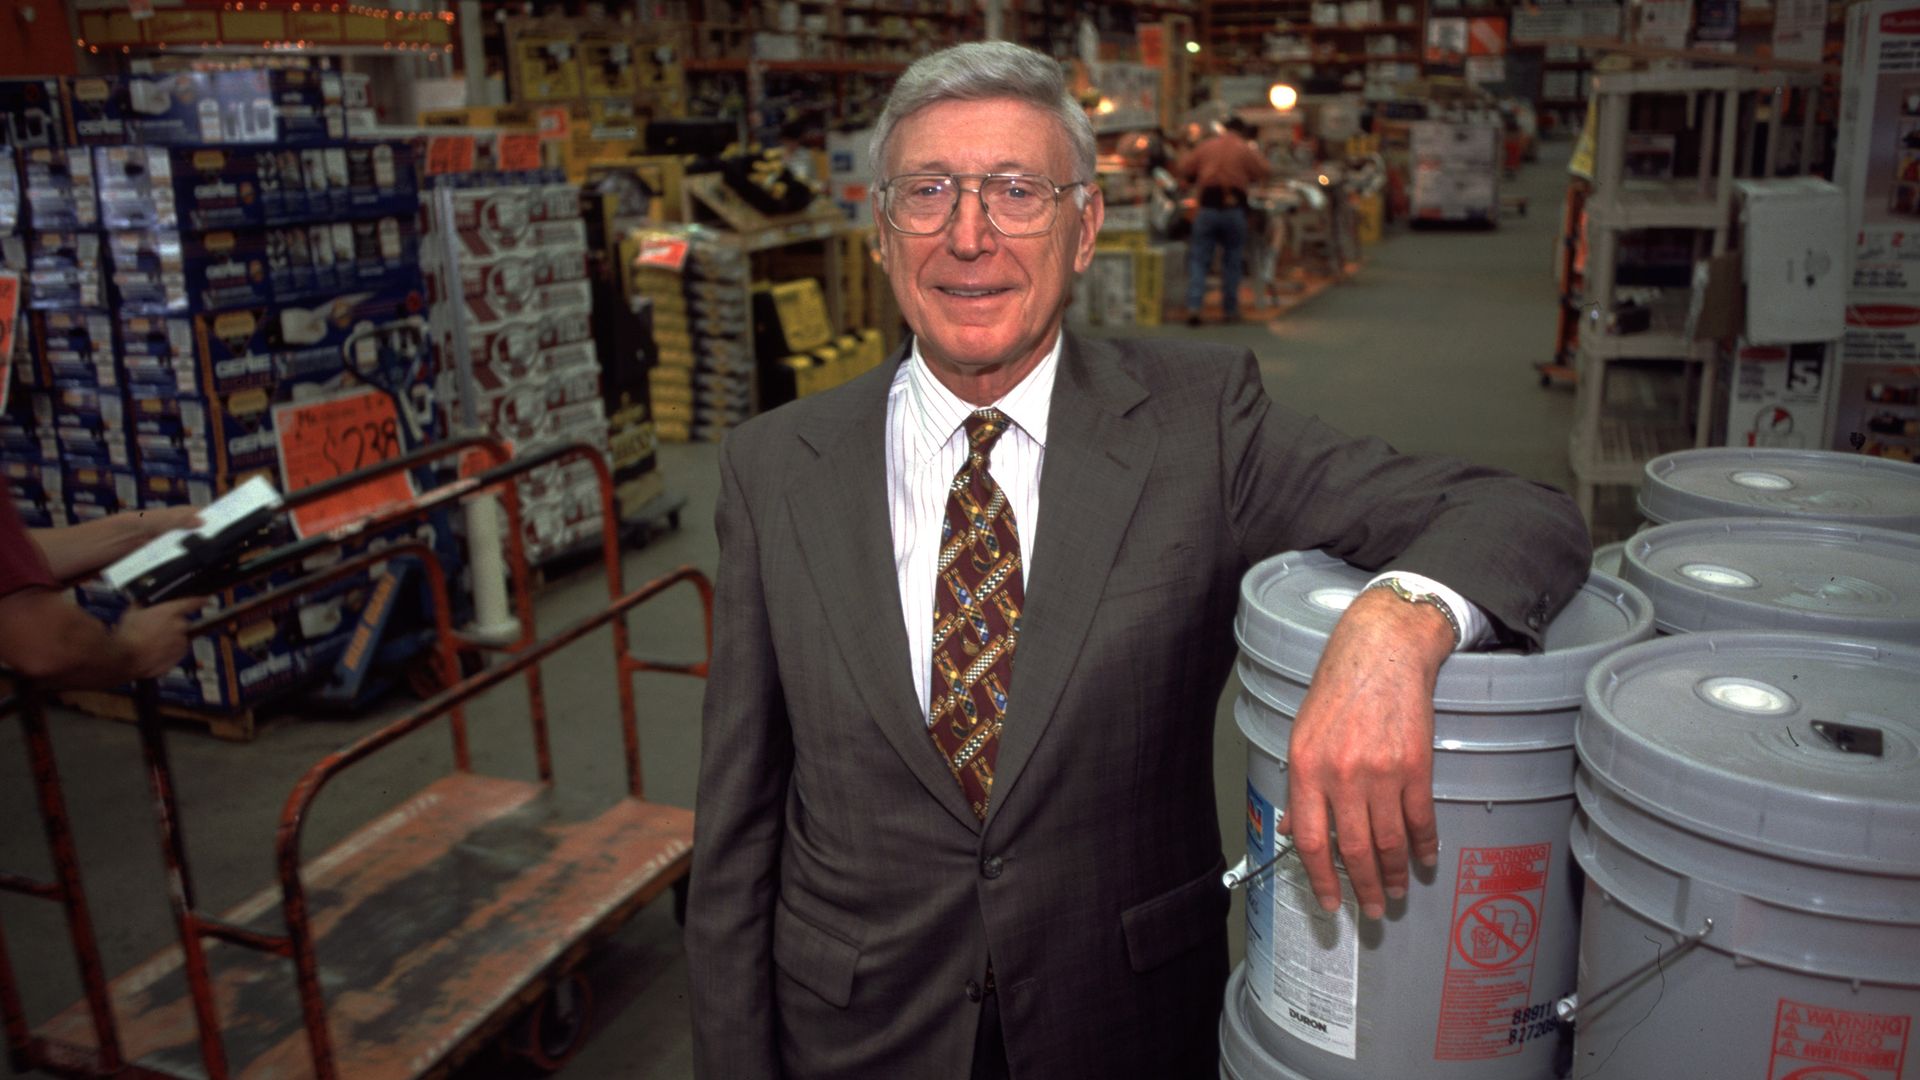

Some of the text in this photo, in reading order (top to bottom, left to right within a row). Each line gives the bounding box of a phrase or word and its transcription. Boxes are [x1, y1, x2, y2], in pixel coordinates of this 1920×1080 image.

[1481, 846, 1546, 863] WARNING
[1288, 1007, 1327, 1033] DURON
[1512, 1000, 1552, 1025] 88911
[1807, 1008, 1902, 1036] WARNING
[1821, 1026, 1884, 1049] AVISO
